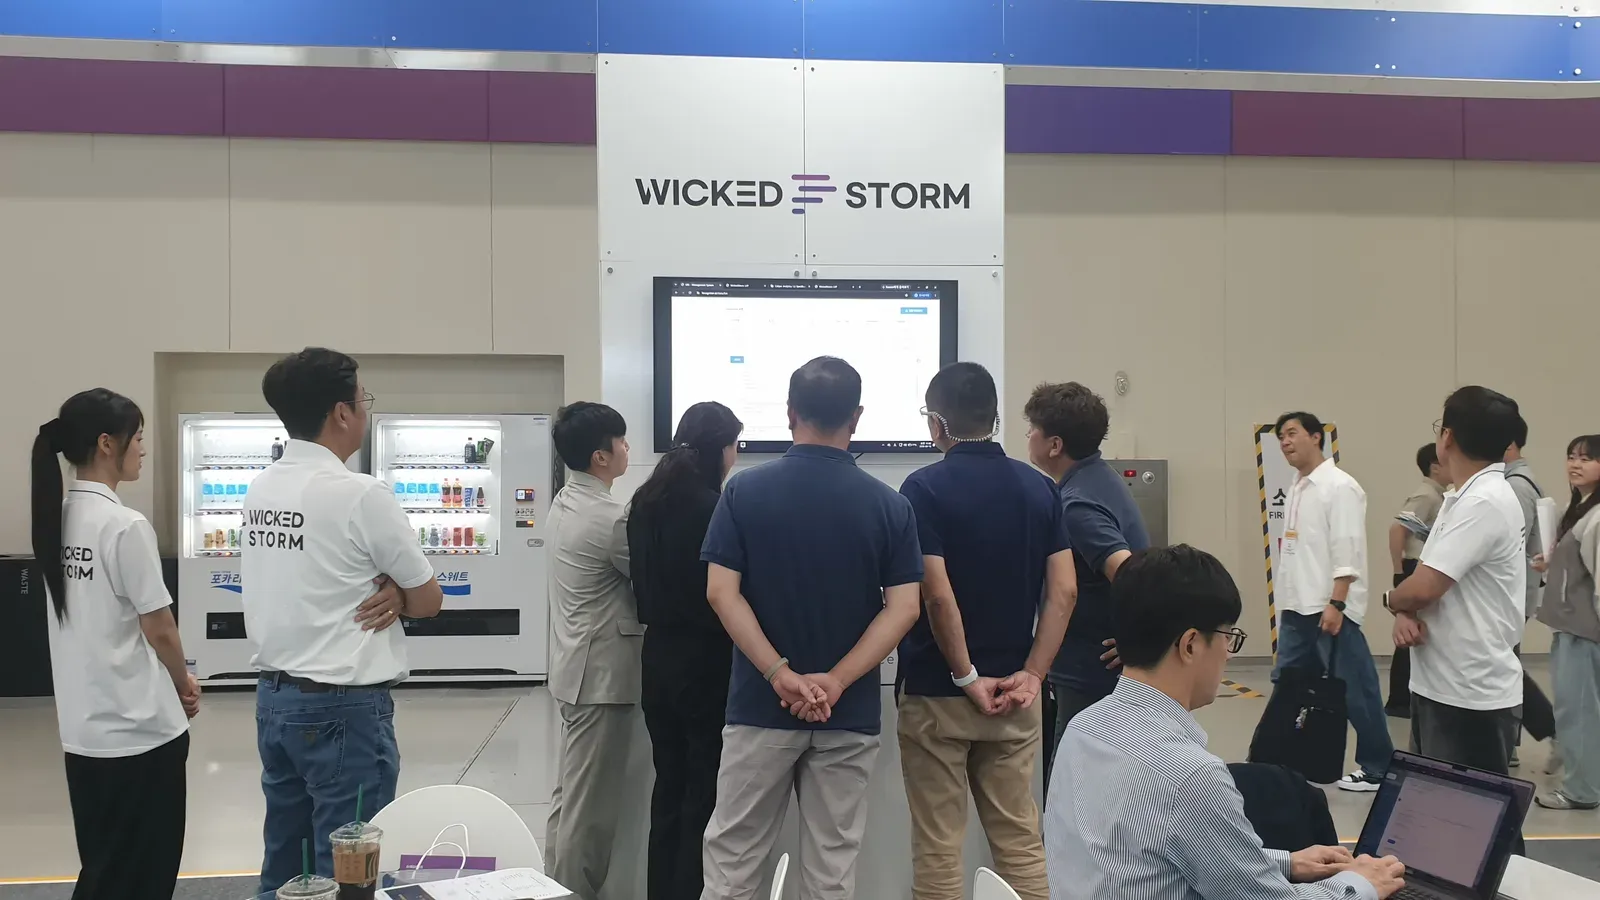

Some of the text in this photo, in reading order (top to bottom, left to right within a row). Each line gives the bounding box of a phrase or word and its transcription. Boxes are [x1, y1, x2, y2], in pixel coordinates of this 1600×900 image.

[635, 178, 970, 209] WICKED STORM
[249, 509, 305, 528] WICKED
[1269, 511, 1285, 519] FIR
[249, 530, 304, 551] STORM
[61, 546, 93, 561] ICKED
[20, 568, 29, 595] WASTE
[436, 571, 469, 582] 스웨트
